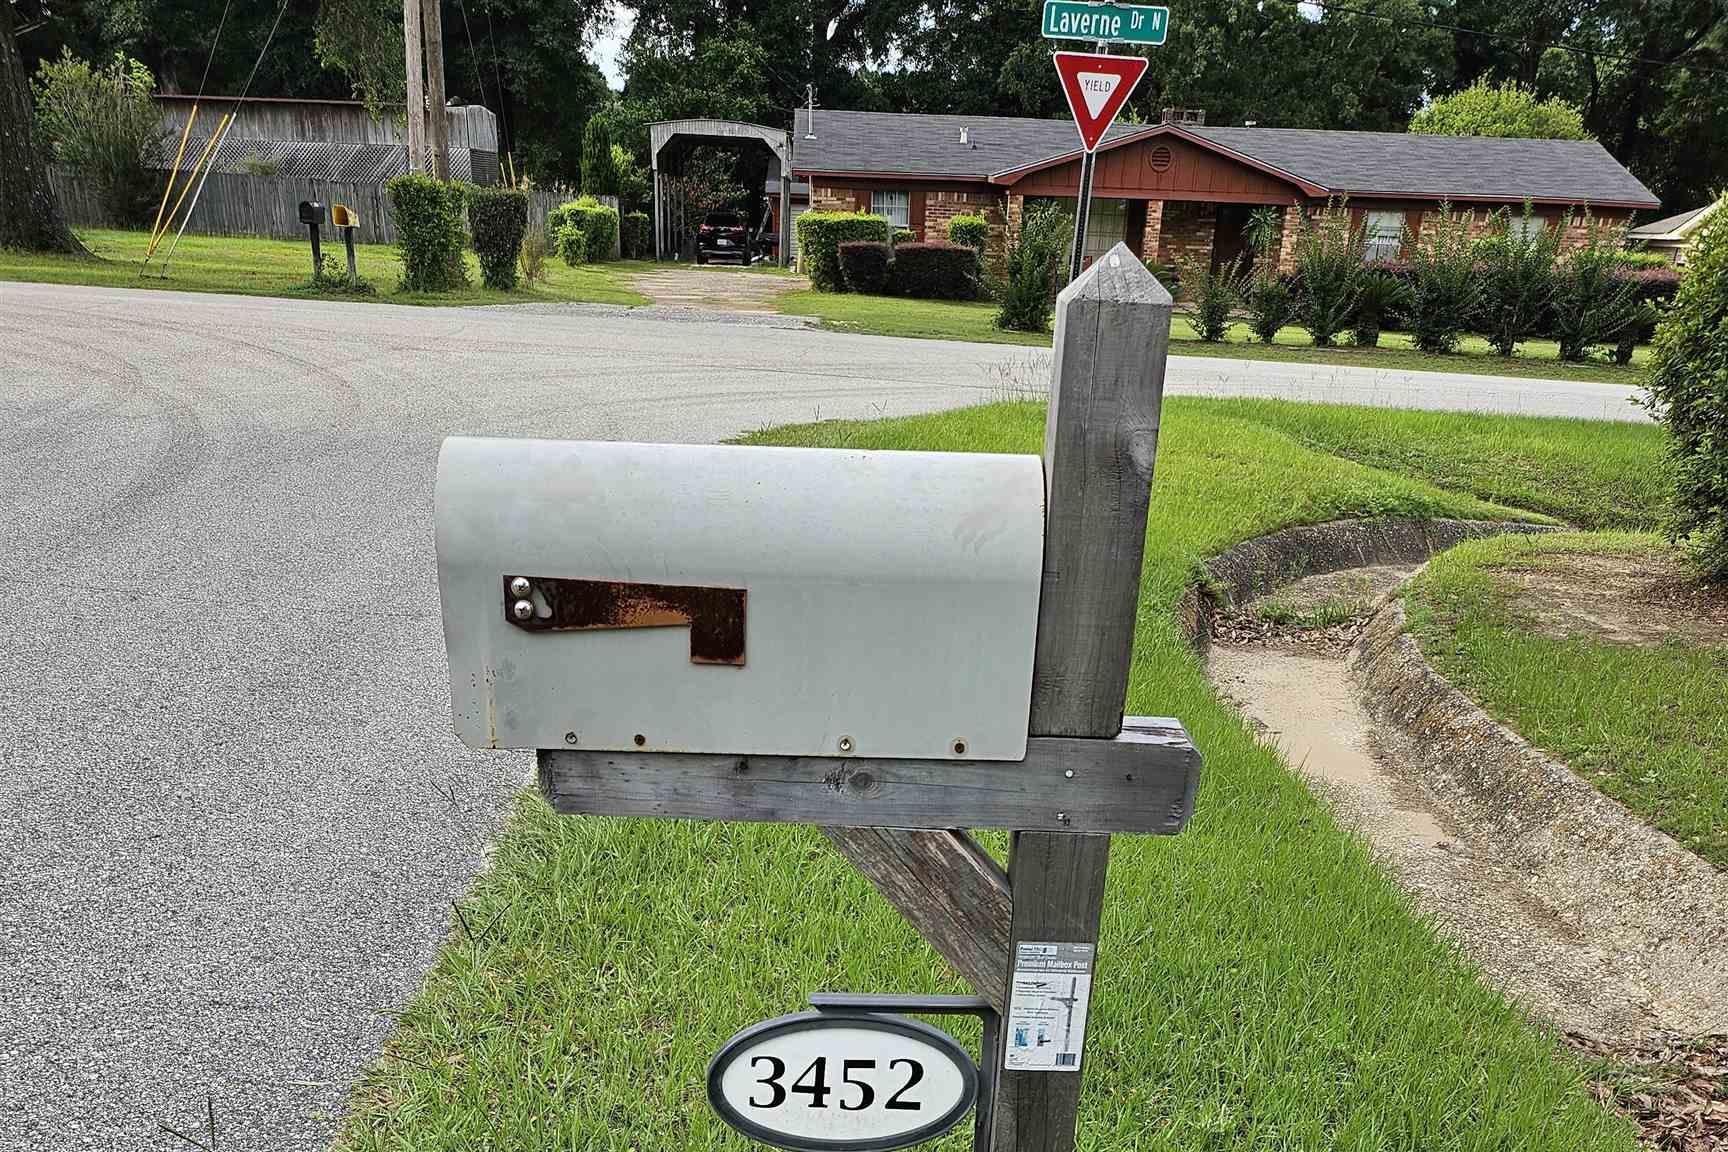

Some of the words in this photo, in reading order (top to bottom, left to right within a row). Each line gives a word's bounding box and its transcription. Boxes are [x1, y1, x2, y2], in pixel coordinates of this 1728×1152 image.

[1050, 5, 1120, 36] Laverne
[1130, 11, 1144, 29] Dr
[1152, 12, 1161, 31] N
[1085, 79, 1111, 92] YIELD
[749, 1056, 924, 1111] 3452
